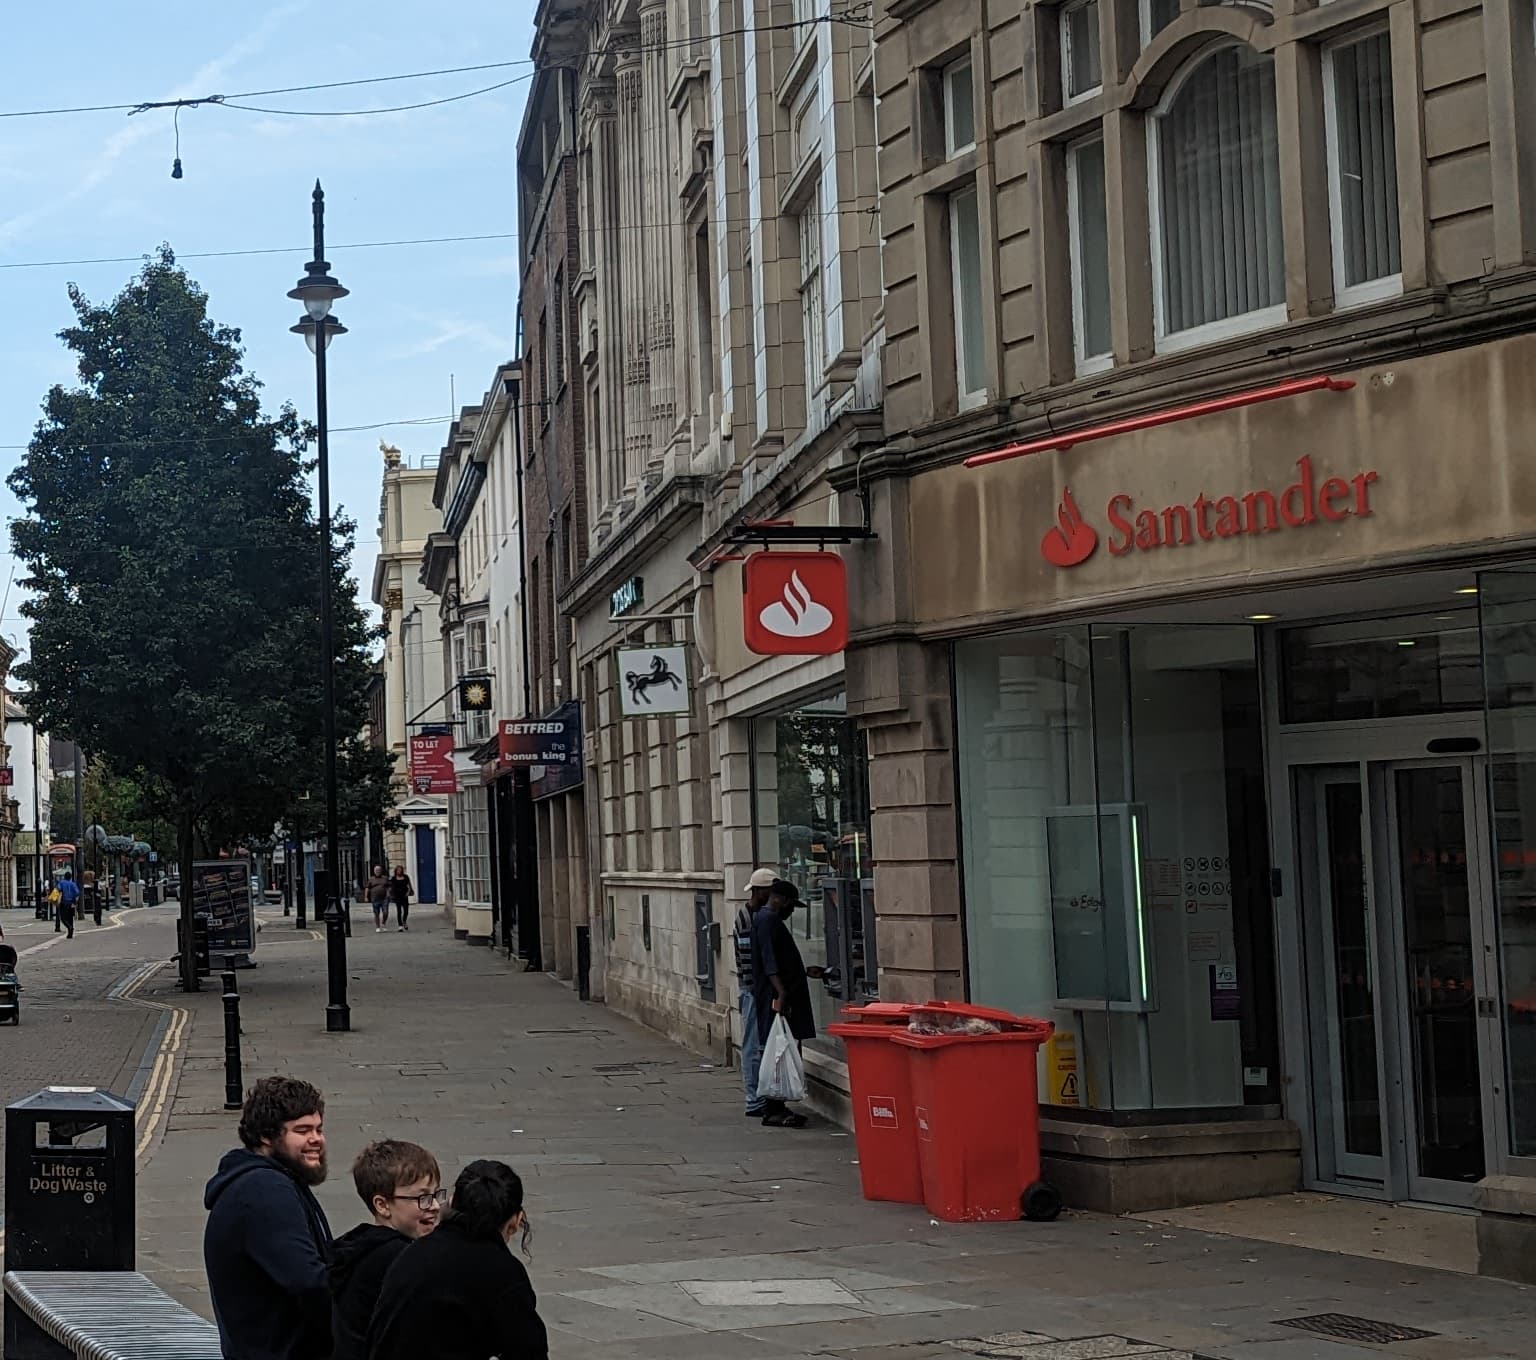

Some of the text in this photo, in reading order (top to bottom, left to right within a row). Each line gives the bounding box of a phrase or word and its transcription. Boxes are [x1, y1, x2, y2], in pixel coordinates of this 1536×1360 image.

[1107, 455, 1378, 557] Santander
[505, 722, 564, 734] BETFRED
[413, 740, 439, 748] TO LET
[551, 742, 565, 750] the
[504, 751, 566, 760] bonus king
[41, 1163, 95, 1176] Litter &
[30, 1176, 108, 1194] Dog Waste
